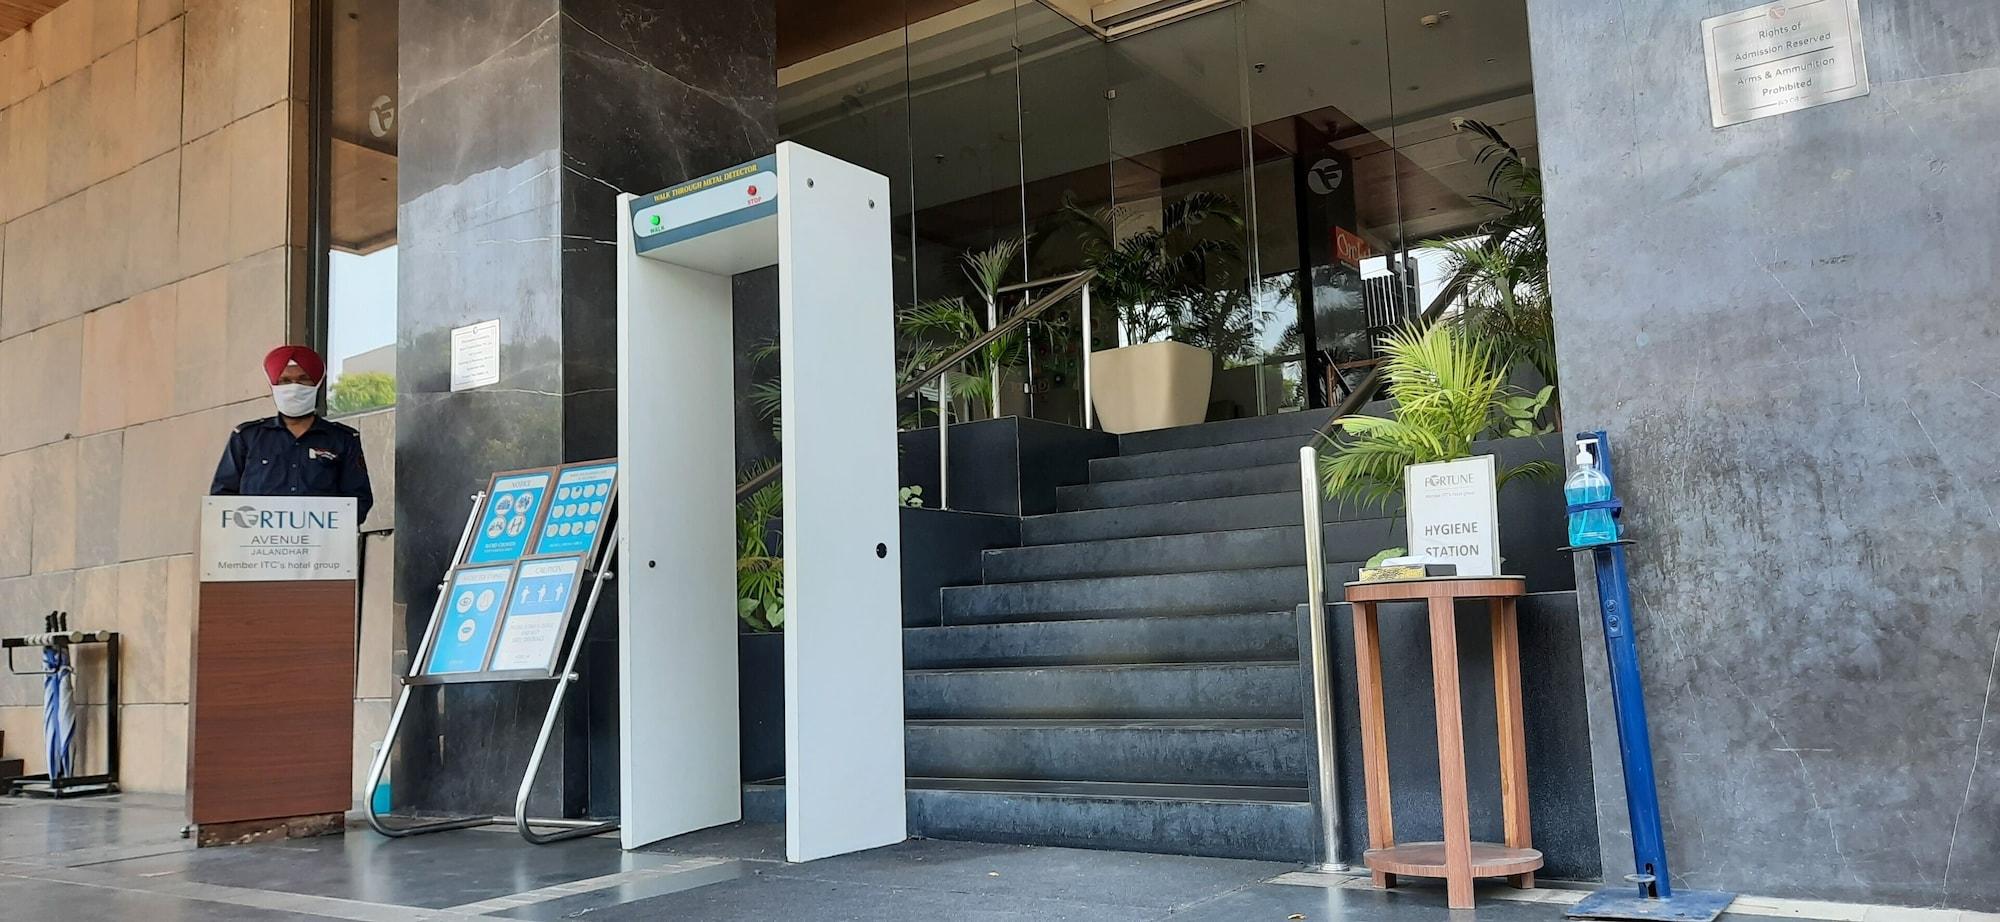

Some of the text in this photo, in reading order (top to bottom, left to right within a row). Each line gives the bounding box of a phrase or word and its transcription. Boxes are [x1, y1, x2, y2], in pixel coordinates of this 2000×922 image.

[1758, 22, 1802, 39] Rights of
[1734, 32, 1832, 62] Admission Reserved
[1737, 57, 1835, 86] Arms & Ammunition
[1762, 78, 1812, 97] Prohibited
[653, 164, 758, 202] WALK THROUGH METAL DETECTOR
[747, 196, 762, 205] STOP
[650, 226, 665, 234] WALK
[221, 505, 340, 530] FORTUNE
[1425, 522, 1479, 536] HYGIENE
[251, 535, 310, 545] AVENUE
[251, 548, 310, 556] JALANDHAR
[1425, 544, 1479, 558] STATION
[217, 560, 340, 570] Member ITC's hotel group
